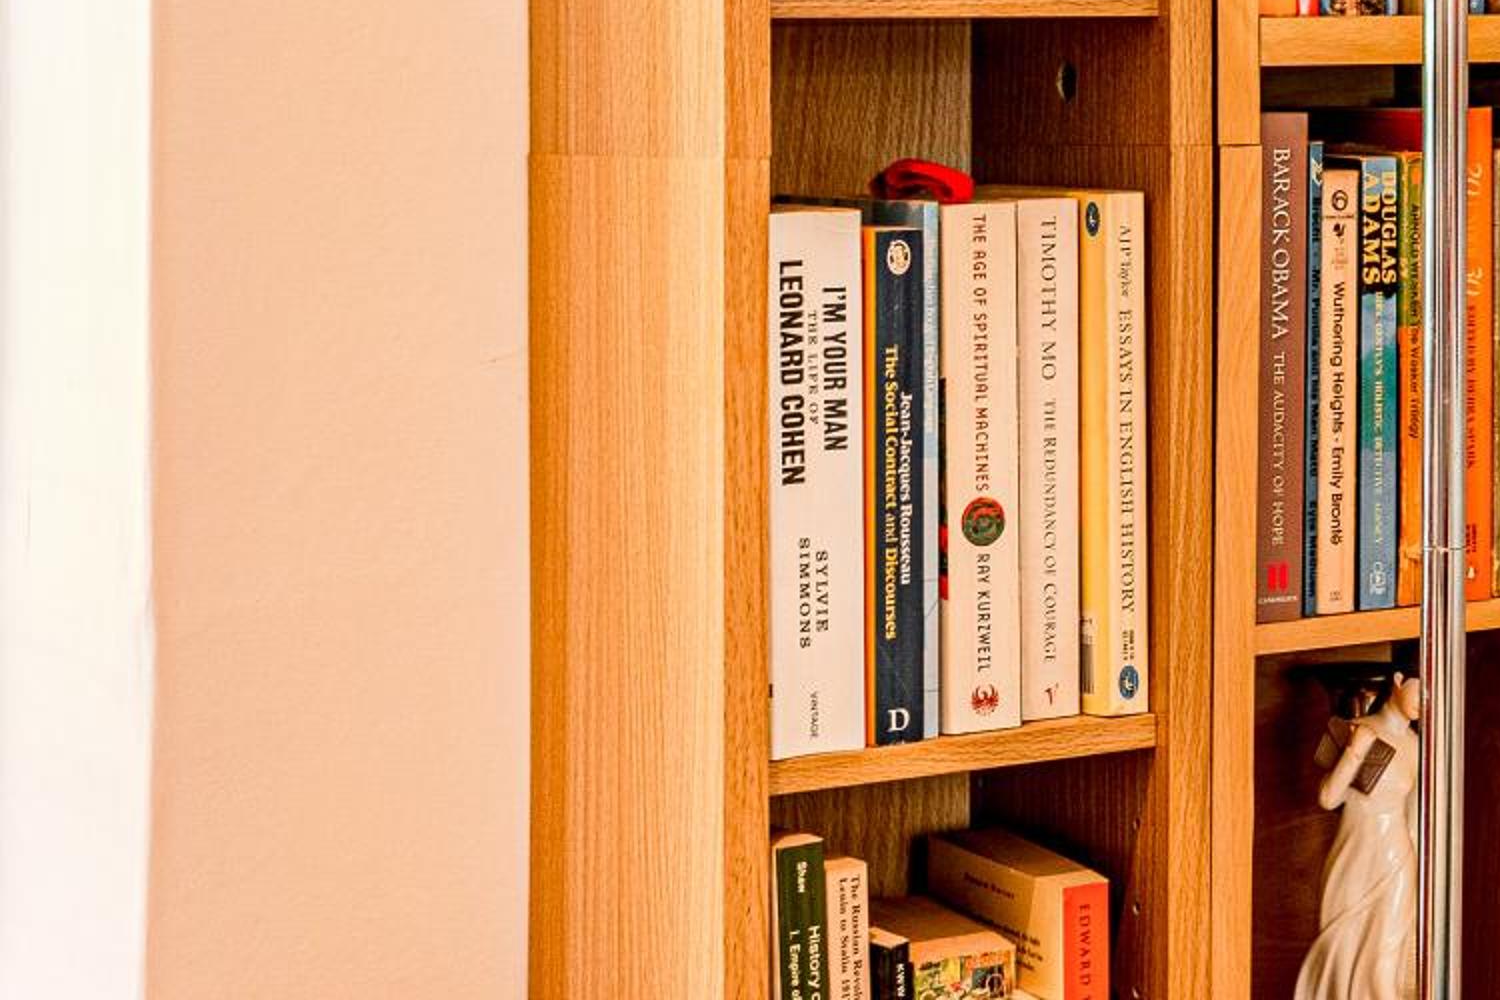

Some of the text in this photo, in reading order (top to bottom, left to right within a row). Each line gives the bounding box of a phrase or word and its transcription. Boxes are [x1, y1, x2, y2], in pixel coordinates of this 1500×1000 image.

[1271, 148, 1291, 340] BARACK OBAMA
[1363, 172, 1381, 285] ADAMS
[1381, 170, 1397, 284] DOUGLAS
[1041, 216, 1057, 381] TIMOTHY MO
[1117, 261, 1131, 298] Taylor
[807, 310, 819, 426] THE LIFE OF
[972, 213, 989, 492] THE AGE OF SPIRITUAL MACHINES
[1119, 310, 1133, 384] ESSAYS
[1331, 281, 1346, 367] Wuthering
[779, 259, 806, 486] LEONARD COHEN
[823, 287, 848, 451] I'M YOUR MAN
[1119, 390, 1133, 413] IN
[1332, 371, 1345, 434] Heights
[884, 344, 899, 640] The Social Contract and Discourses
[899, 391, 914, 584] Jean-Jacques Rousseau
[1120, 421, 1135, 514] ENGLISH
[1272, 351, 1285, 546] THE AUDACITY OF HOPE
[1329, 447, 1345, 489] Emily
[1043, 398, 1058, 664] THE REDUNDANCY OF COURAGE
[1121, 523, 1136, 613] HISTORY
[799, 537, 811, 649] SIMMONS
[816, 550, 829, 632] SYLVIE
[976, 552, 991, 673] RAY KURZWEIL
[810, 691, 819, 740] VINTAGE
[886, 708, 911, 732] D
[841, 919, 850, 932] to
[850, 874, 861, 901] The
[852, 904, 862, 955] Russian
[788, 943, 801, 987] Empire
[808, 925, 821, 989] History
[841, 935, 850, 974] Stalin
[1079, 903, 1091, 986] EDWARD
